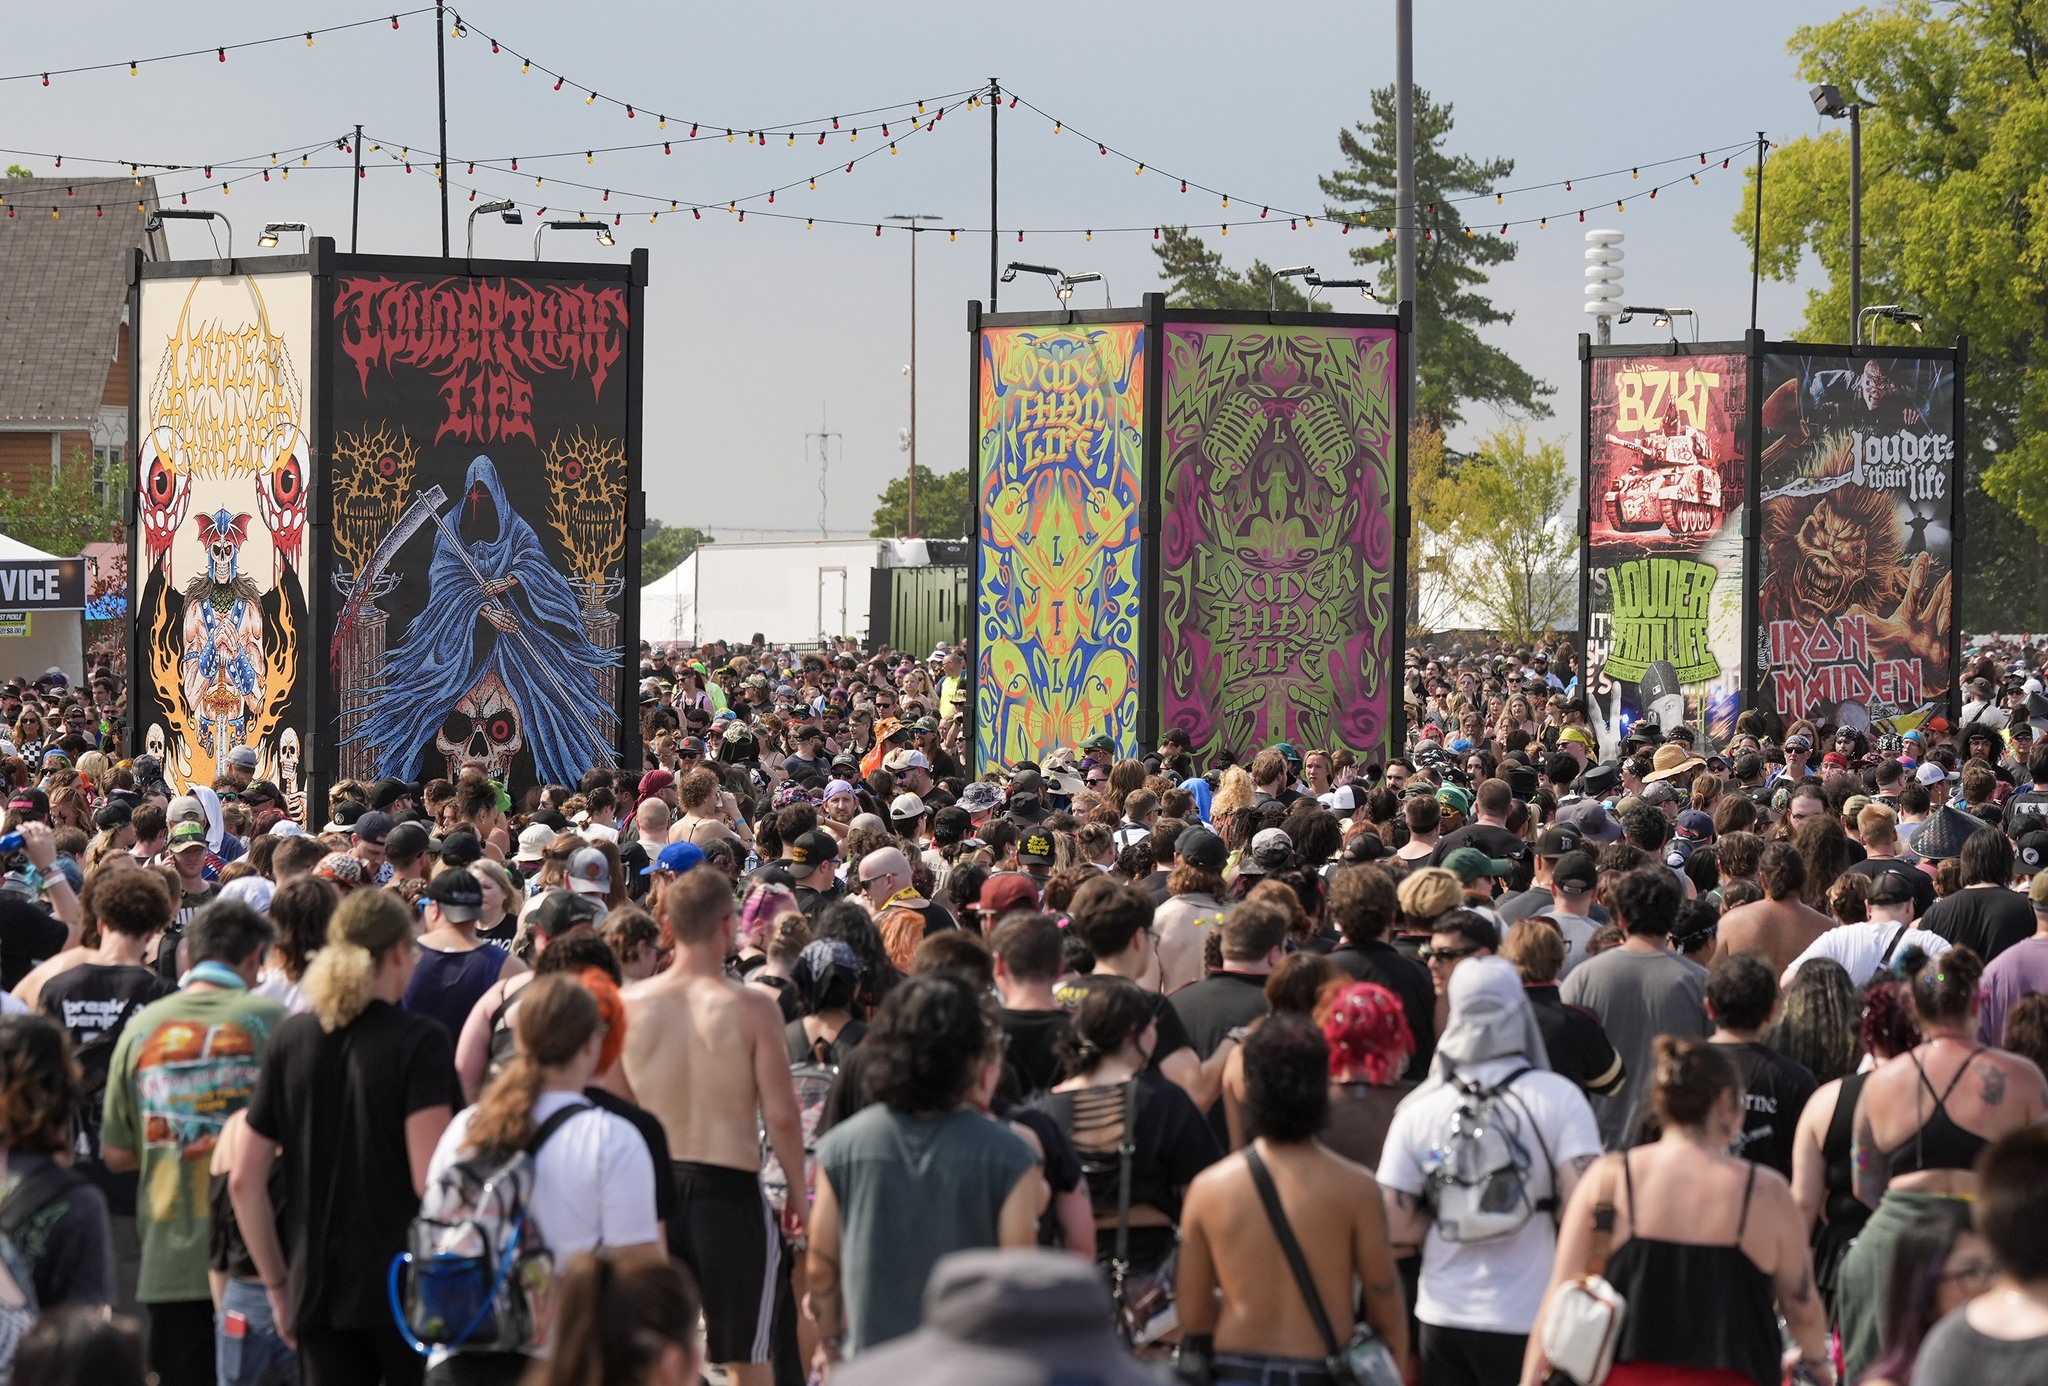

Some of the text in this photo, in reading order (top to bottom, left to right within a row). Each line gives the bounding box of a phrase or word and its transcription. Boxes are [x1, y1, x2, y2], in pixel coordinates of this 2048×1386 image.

[334, 276, 507, 395] LOUDER
[1003, 331, 1122, 393] LOUDER
[1623, 363, 1658, 373] LIMP
[435, 361, 537, 447] LIFE
[1014, 388, 1106, 432] THAN
[1615, 368, 1720, 432] BZKT
[1022, 428, 1094, 474] LIFE
[1866, 464, 1946, 501] than life
[0, 569, 60, 601] VICE
[1195, 544, 1360, 602] LOUDER
[1606, 558, 1718, 619] LOUDER
[1209, 600, 1340, 645] THAN
[1615, 618, 1666, 662] THAN
[1666, 618, 1715, 668] LIFE
[1769, 614, 1869, 675] IRON
[1223, 641, 1324, 687] LIFE
[1771, 658, 1923, 720] MAIDEN
